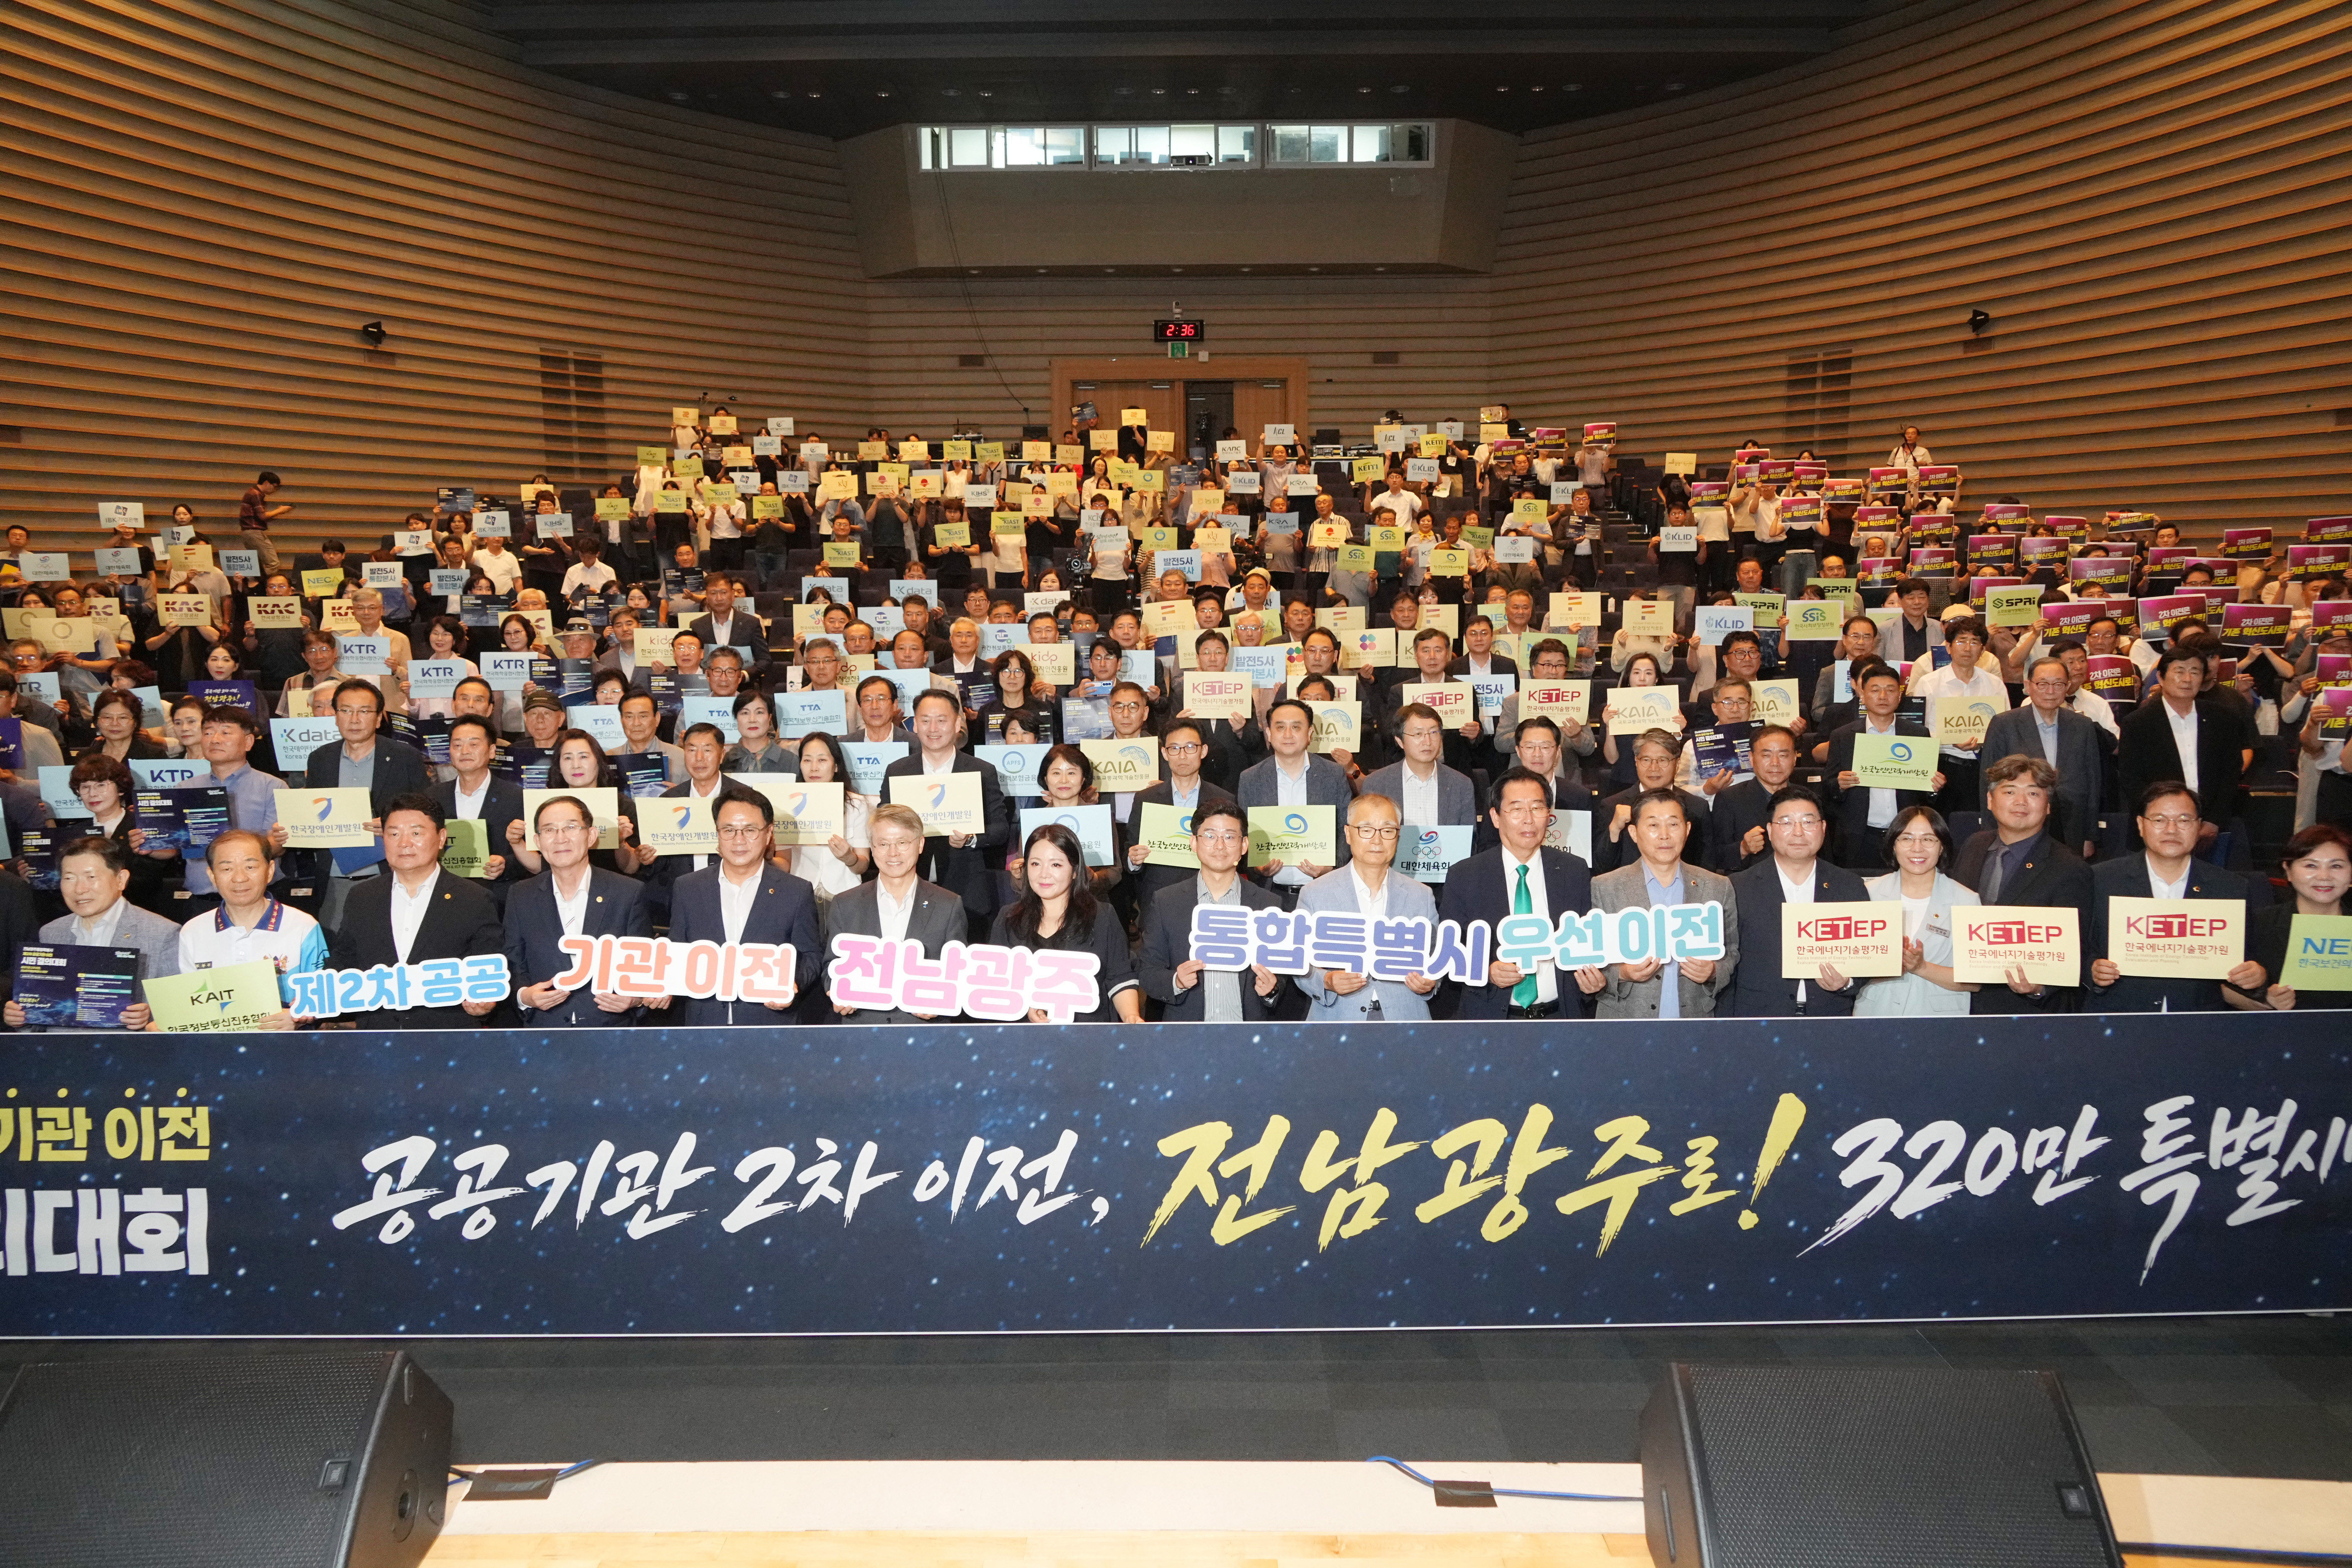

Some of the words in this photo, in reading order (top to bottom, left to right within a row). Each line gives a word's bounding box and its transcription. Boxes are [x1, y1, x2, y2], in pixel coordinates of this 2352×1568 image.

[1167, 324, 1194, 336] 2:36
[1671, 532, 1692, 541] KLID
[1163, 557, 1193, 566] 발전5사
[165, 601, 204, 612] KAC
[1750, 601, 1779, 610] SPRi
[2006, 597, 2035, 606] SPRi
[257, 603, 295, 614] KAC
[1802, 611, 1826, 622] SSiS
[1715, 617, 1744, 629] KLID
[343, 644, 376, 654] KTR
[1031, 650, 1058, 665] kidp
[1235, 655, 1275, 667] 발전5사
[493, 659, 524, 669] KTR
[421, 667, 453, 677] KTR
[1192, 681, 1243, 696] KETEP
[1412, 691, 1464, 706] KETEP
[1477, 696, 1504, 707] 합본사
[1528, 688, 1581, 704] KETEP
[1751, 700, 1778, 712] AIA
[1617, 706, 1658, 719] KAIA
[1944, 715, 1984, 728] KAIA
[1310, 722, 1338, 735] AIA
[1091, 760, 1137, 774] KAIA
[1860, 765, 1929, 777] 한국노인인력개발원
[150, 769, 194, 782] KTR
[917, 810, 972, 822] 장애인개발원
[291, 823, 361, 833] 한국장애인개발원
[774, 820, 832, 830] 국장애인개발원
[651, 832, 719, 841] 한국장애인개발원
[1147, 839, 1191, 851] 한국노인인력
[1256, 841, 1327, 851] 한국노인인력개발원
[1401, 861, 1450, 871] 대한체육회
[1798, 916, 1887, 941] KETEP
[2127, 914, 2227, 939] KETEP
[1501, 916, 1605, 969] 우선
[1618, 908, 1724, 960] 이전
[1968, 921, 2062, 945] KETEP
[1194, 908, 1488, 980] 통합특별시
[1797, 945, 1888, 955] 한국에너지기술평가원
[2125, 942, 2228, 955] 한국에너지기술평가원
[2303, 938, 2352, 955] NE
[1968, 949, 2066, 962] 한국에너지기술평가원
[558, 939, 672, 994] 기관
[685, 943, 792, 998] 이전
[834, 939, 1094, 1019] 전남광주
[294, 967, 411, 1015] 제2차
[422, 958, 507, 1003] 공공
[191, 989, 234, 1006] KAIT
[104, 1106, 209, 1161] 이전
[332, 1132, 719, 1243] 공공기관
[721, 1137, 903, 1234] 2차
[912, 1129, 1110, 1226] 이전,
[1796, 1104, 2112, 1258] 320만
[2120, 1096, 2352, 1287] 특별시
[0, 1187, 209, 1276] 대회
